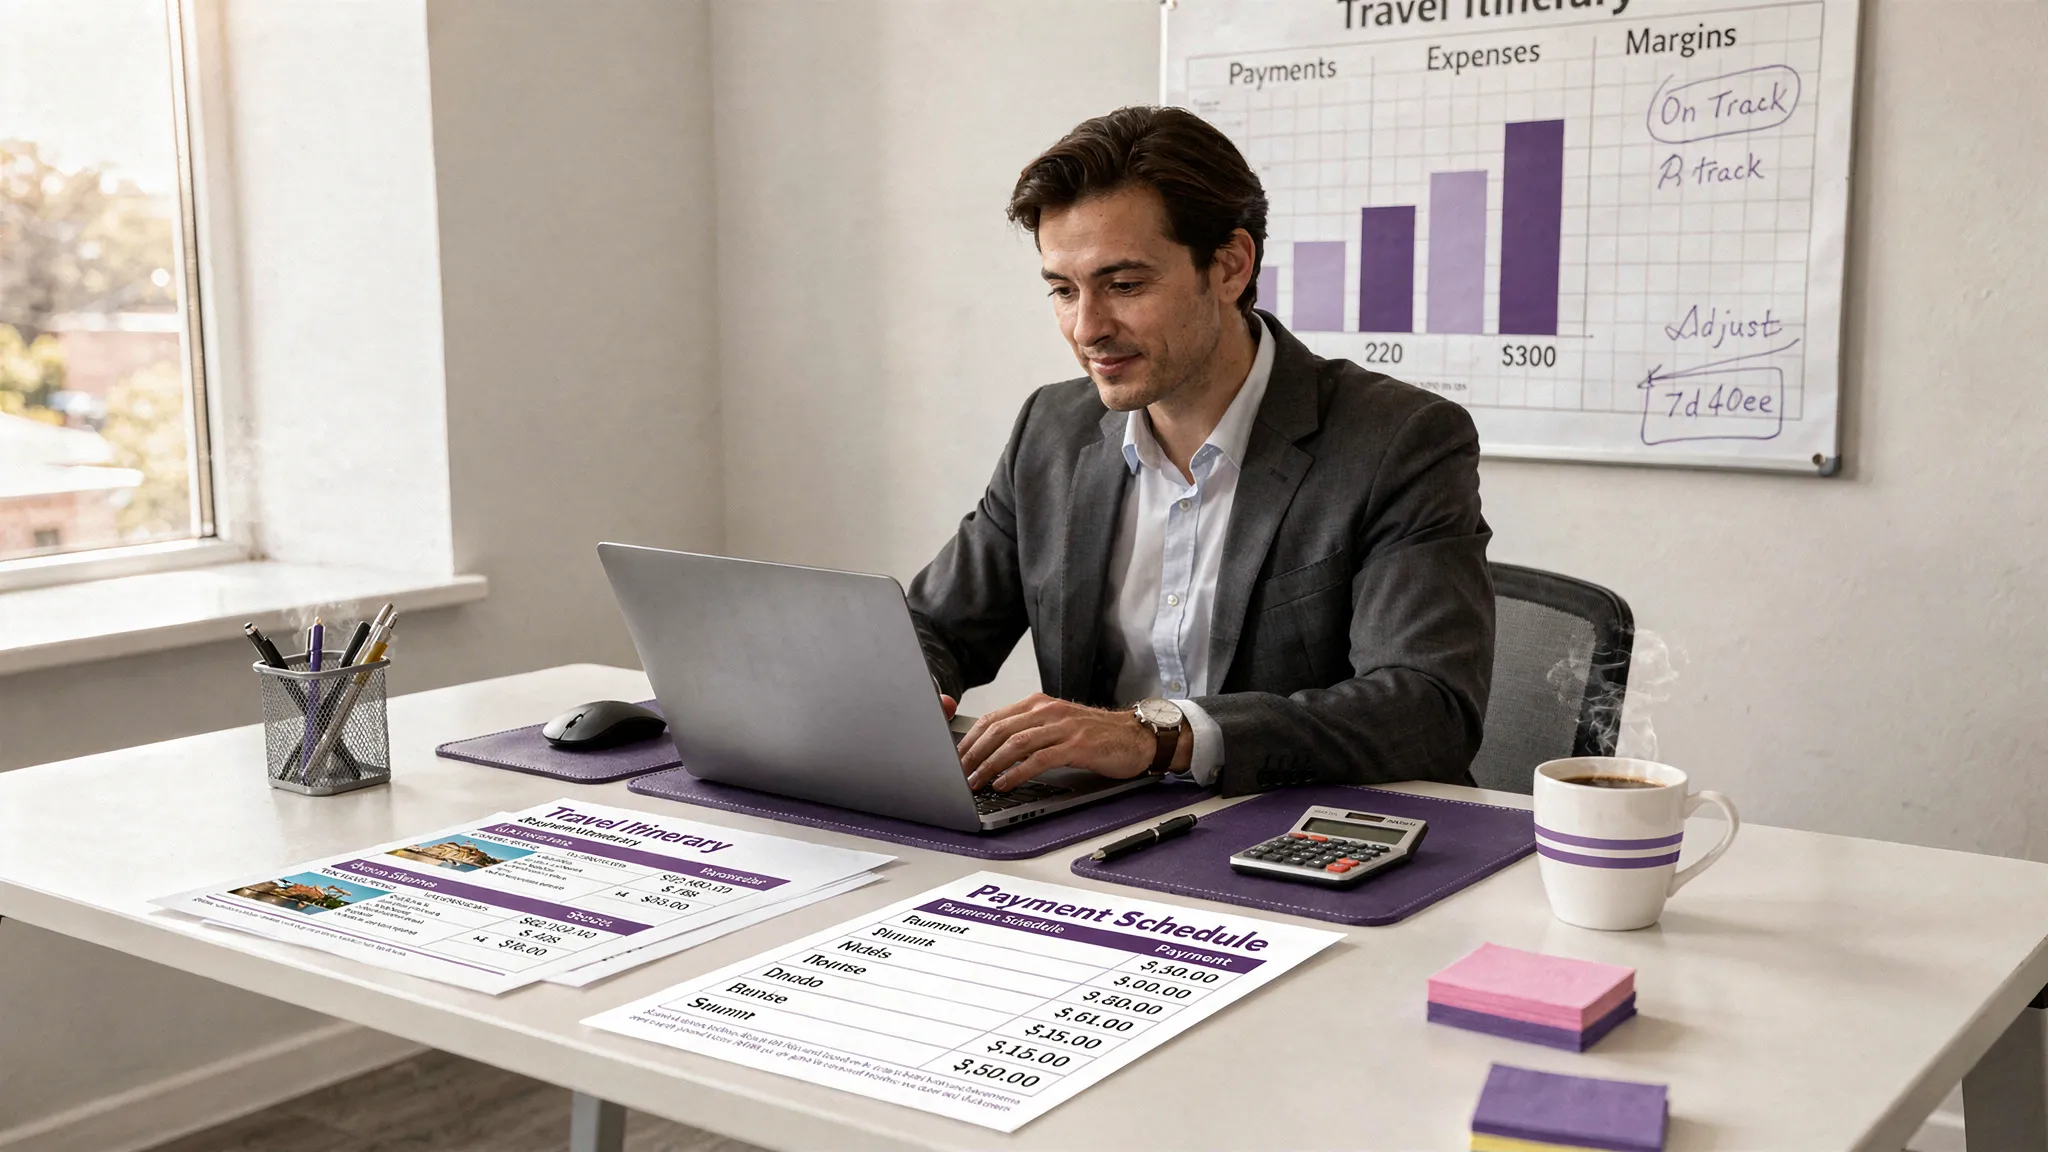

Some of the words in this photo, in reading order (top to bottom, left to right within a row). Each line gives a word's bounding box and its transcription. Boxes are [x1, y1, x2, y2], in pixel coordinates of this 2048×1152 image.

[1337, 0, 1447, 29] Travel
[1625, 23, 1737, 58] Margins
[1228, 56, 1337, 91] Payments
[1426, 43, 1541, 75] Expenses
[1661, 96, 1696, 125] On
[1708, 82, 1788, 119] Track
[1664, 304, 1783, 349] Adjust
[1365, 342, 1403, 364] 220
[1501, 344, 1557, 368] $300
[544, 806, 628, 830] Travel
[619, 819, 734, 854] Itinerary
[965, 884, 1113, 924] Payment
[1113, 910, 1269, 952] Schedule
[1154, 944, 1233, 966] Payment
